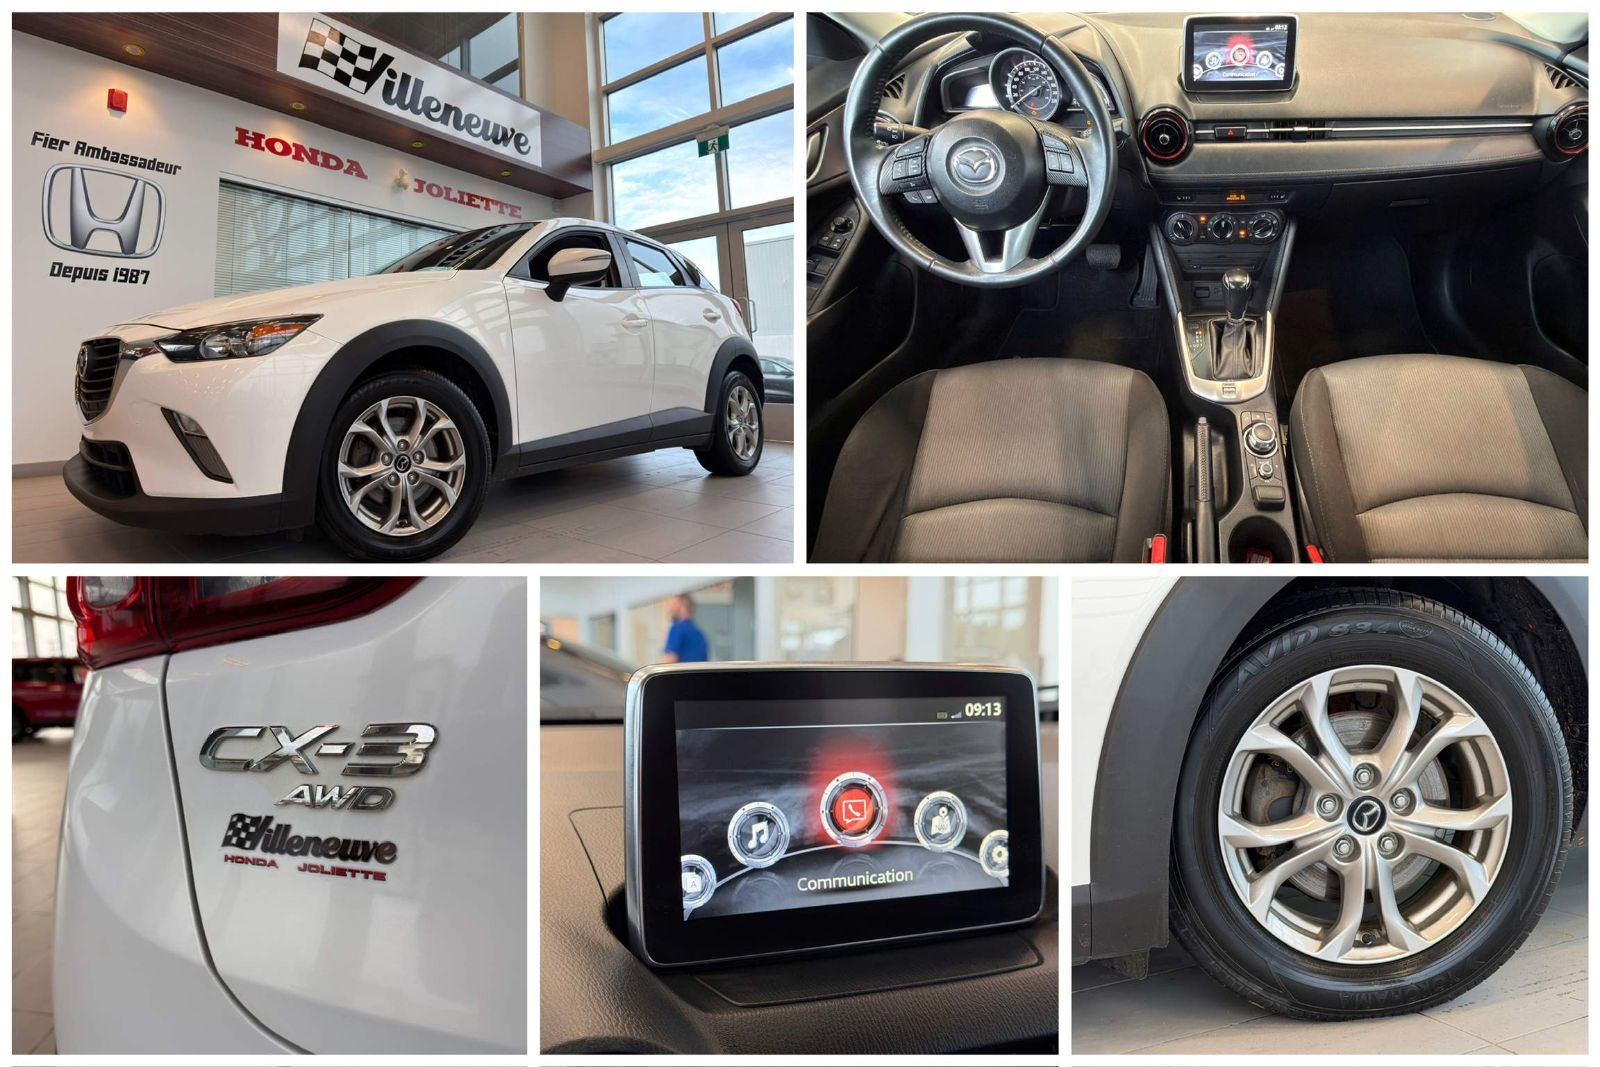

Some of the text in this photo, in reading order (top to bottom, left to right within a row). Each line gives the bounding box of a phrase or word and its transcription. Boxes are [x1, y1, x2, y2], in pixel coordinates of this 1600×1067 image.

[299, 18, 531, 155] Villeneuve
[31, 131, 182, 175] Fier Ambassadeur
[235, 126, 522, 219] HONDA JOLIETTE
[49, 261, 150, 285] Depuis 1987
[964, 702, 1002, 717] 09:13
[199, 722, 440, 778] CX-3
[274, 783, 396, 811] AWD
[221, 812, 398, 865] Villeneuve
[224, 854, 387, 882] HONDA JOLIETTE
[797, 868, 914, 892] Communication
